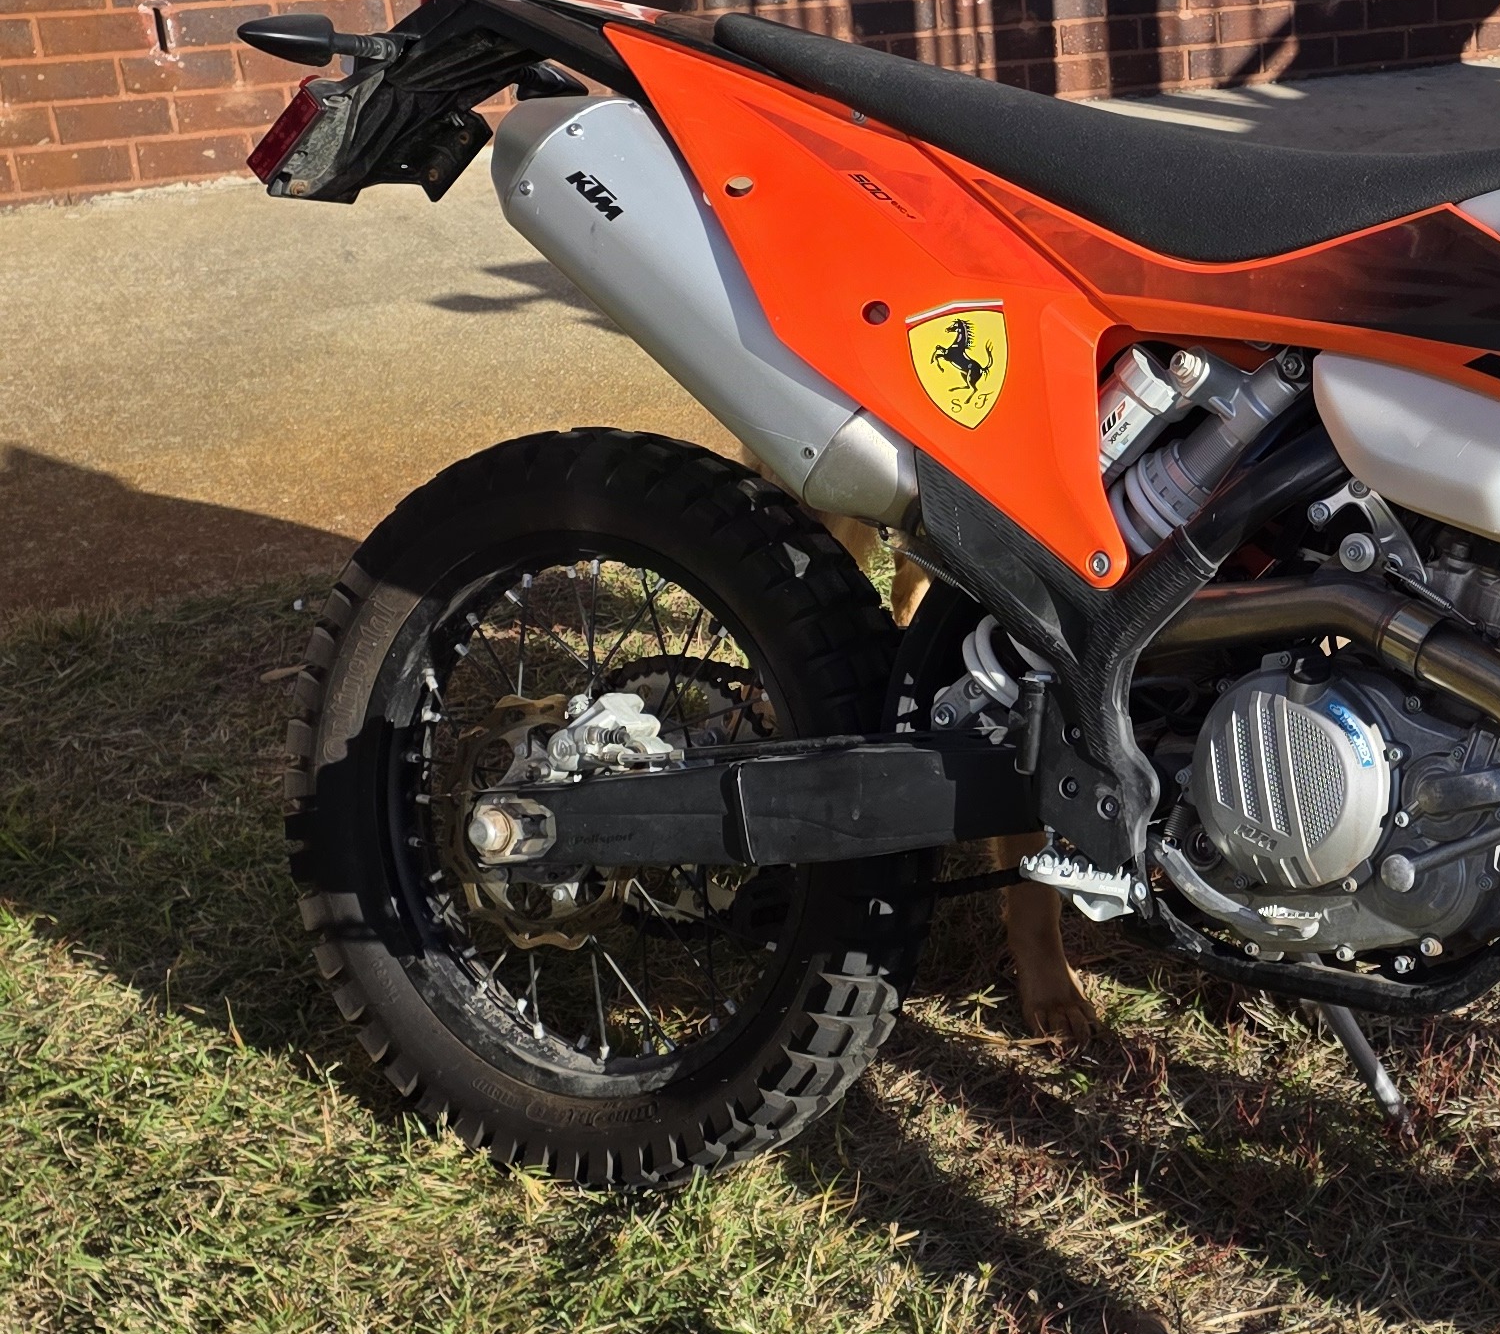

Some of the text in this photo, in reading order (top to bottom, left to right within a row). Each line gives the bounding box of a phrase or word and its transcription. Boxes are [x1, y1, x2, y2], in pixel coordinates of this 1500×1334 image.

[565, 170, 624, 222] KTM
[847, 174, 893, 201] 500
[951, 391, 994, 413] S F
[1102, 400, 1126, 437] WP
[1108, 421, 1131, 444] XPLOR
